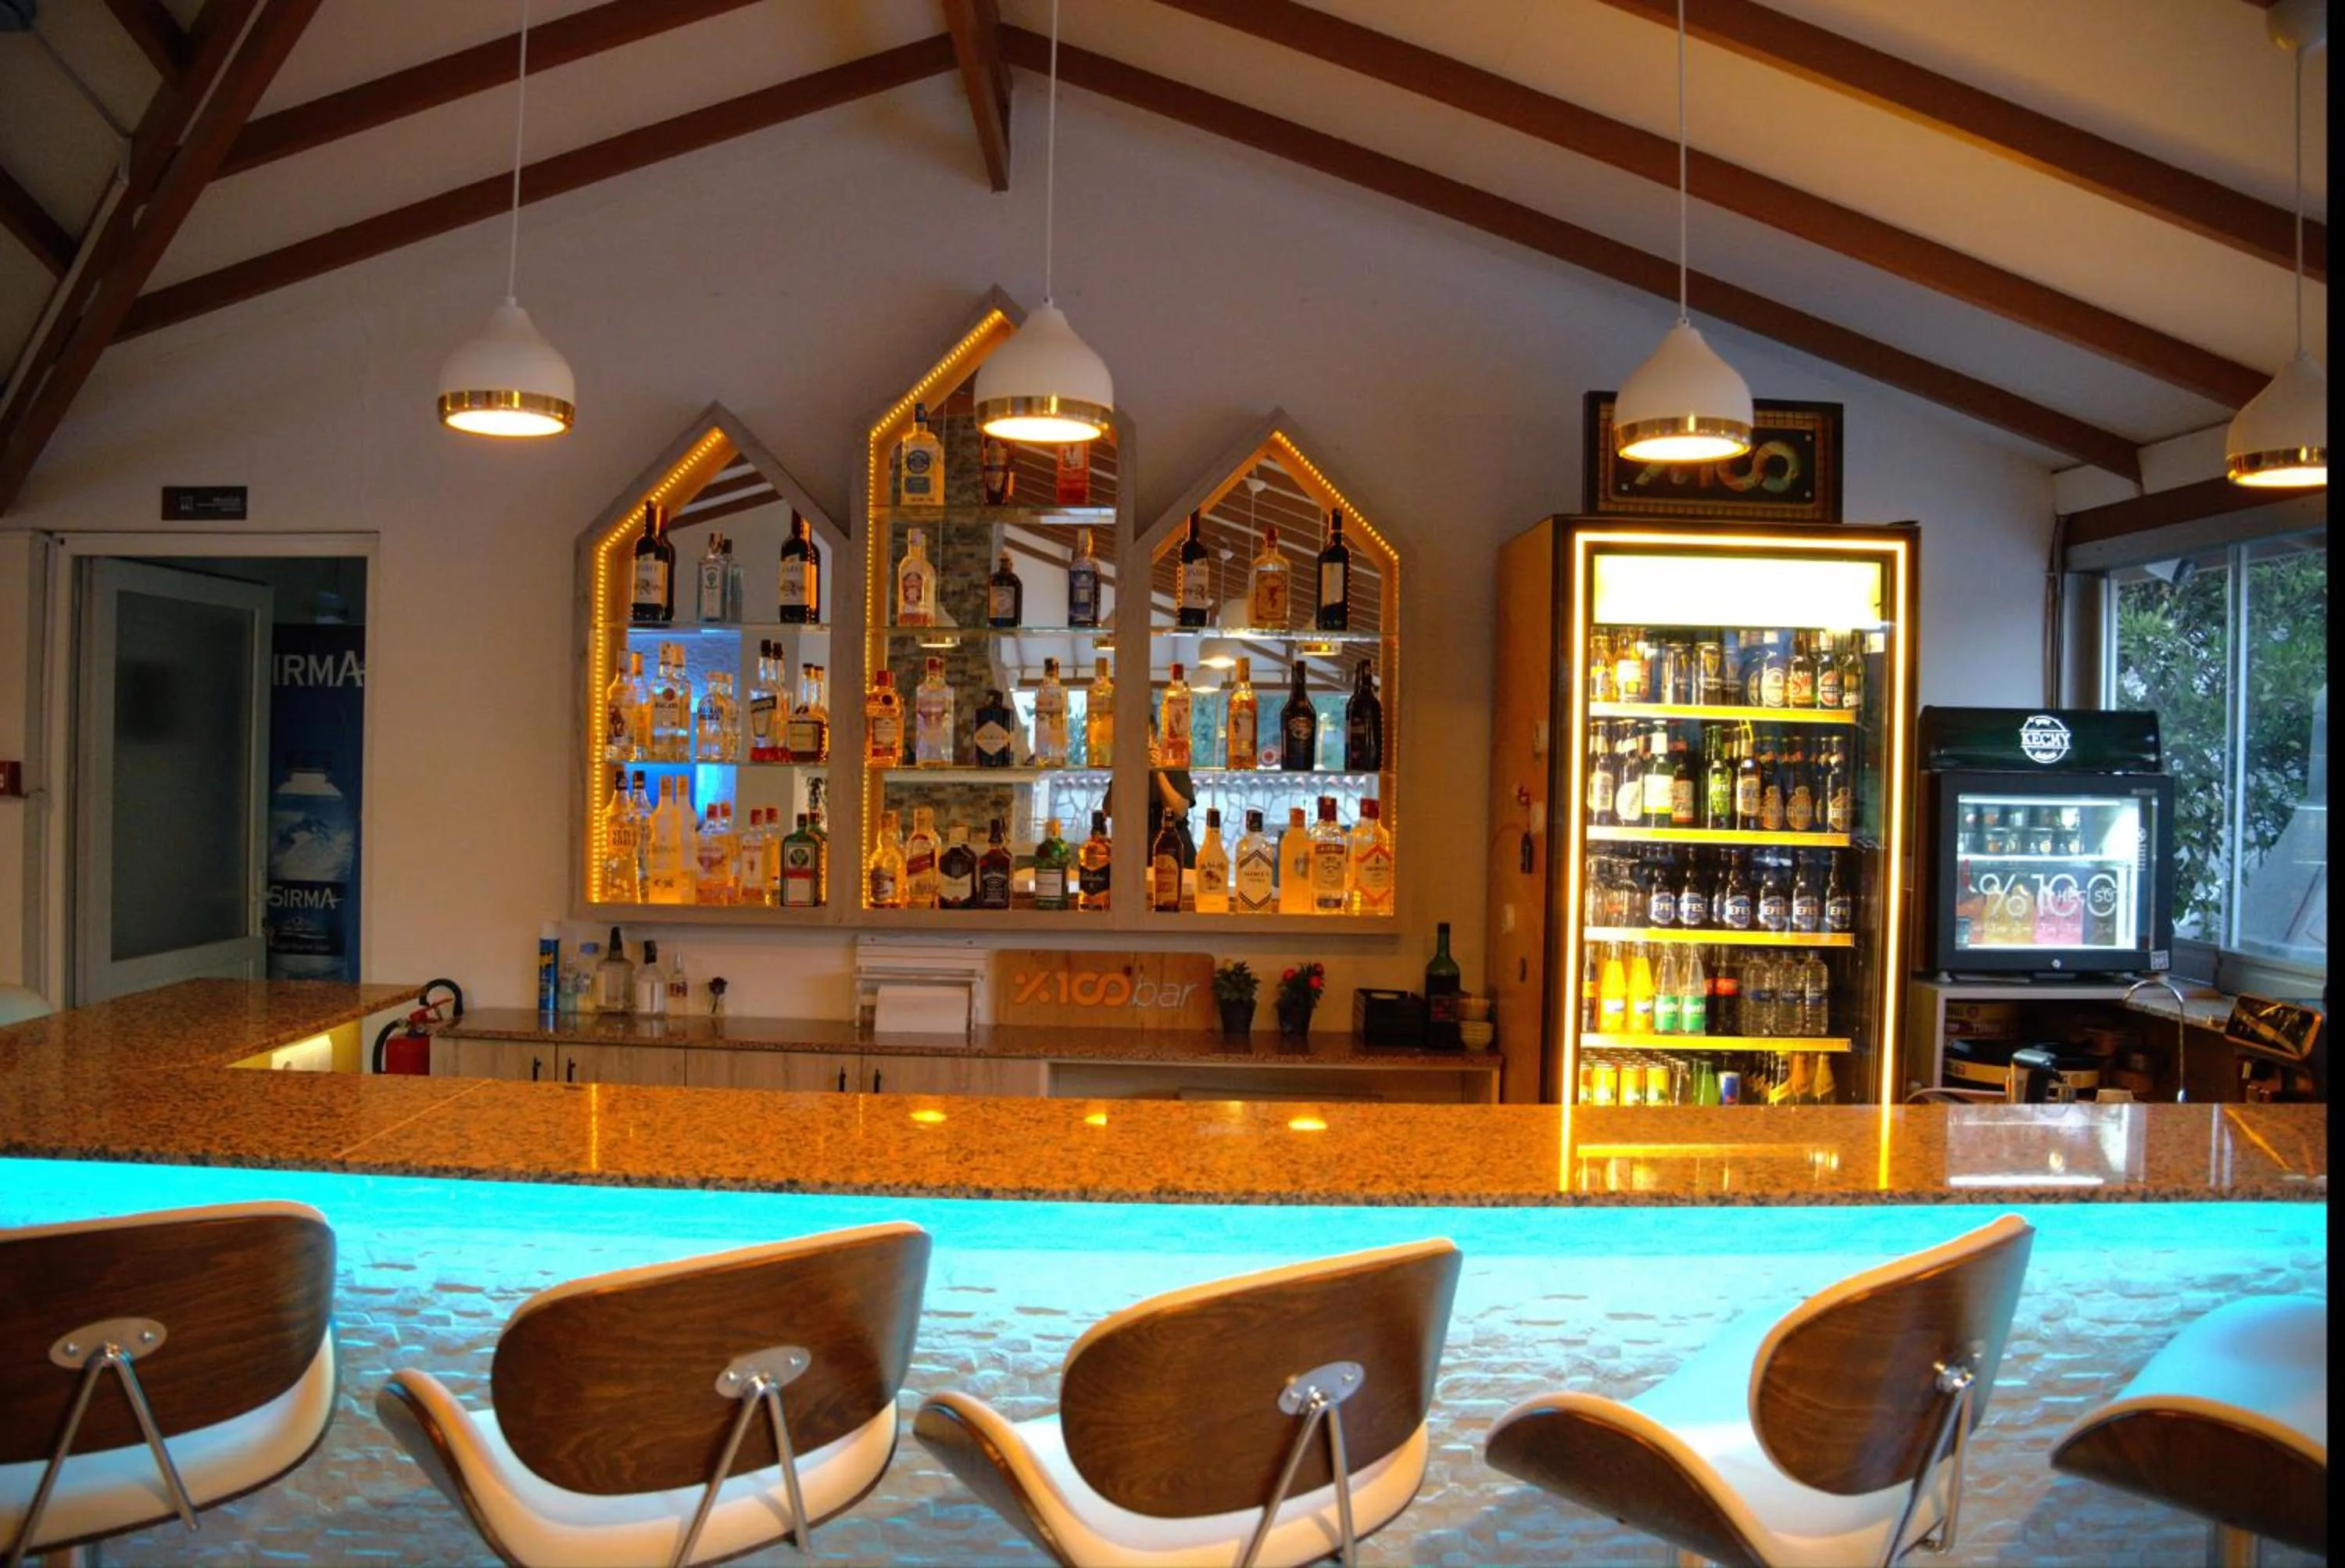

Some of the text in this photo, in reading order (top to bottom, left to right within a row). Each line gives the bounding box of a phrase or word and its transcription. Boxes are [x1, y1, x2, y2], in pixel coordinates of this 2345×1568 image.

[273, 650, 365, 687] IRMA
[268, 885, 342, 910] SIRMA
[1133, 974, 1198, 1009] bar
